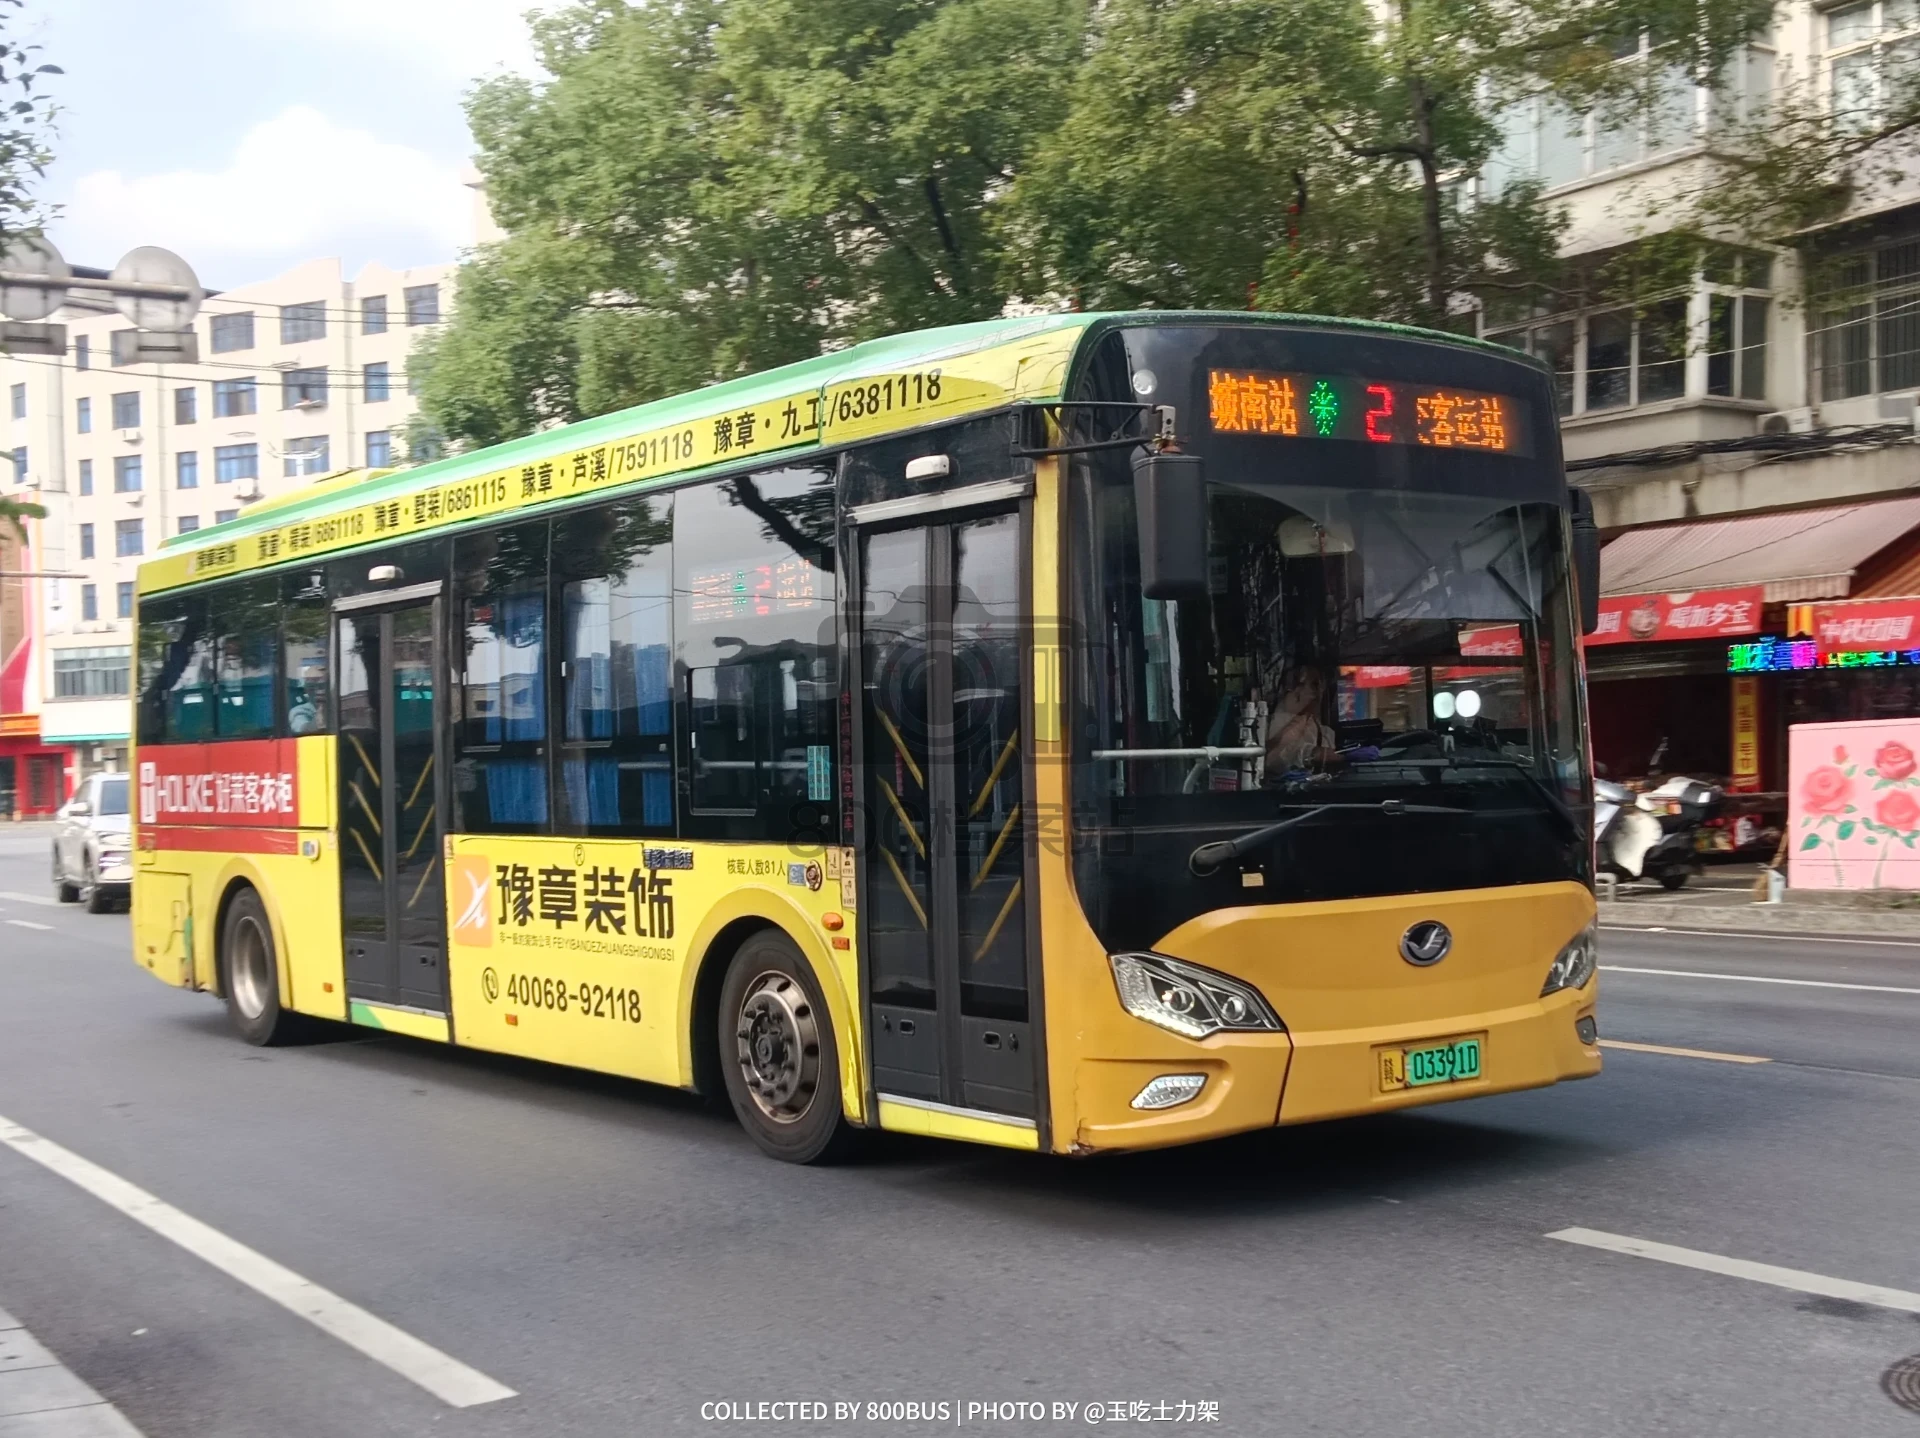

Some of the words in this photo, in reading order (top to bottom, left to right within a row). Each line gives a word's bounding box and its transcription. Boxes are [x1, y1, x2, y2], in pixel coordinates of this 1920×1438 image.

[1366, 385, 1394, 443] 2
[727, 858, 786, 877] 核载人数81人
[496, 863, 675, 940] 豫章装饰
[507, 973, 642, 1024] 40068-92118
[1413, 1044, 1478, 1081] 03391D
